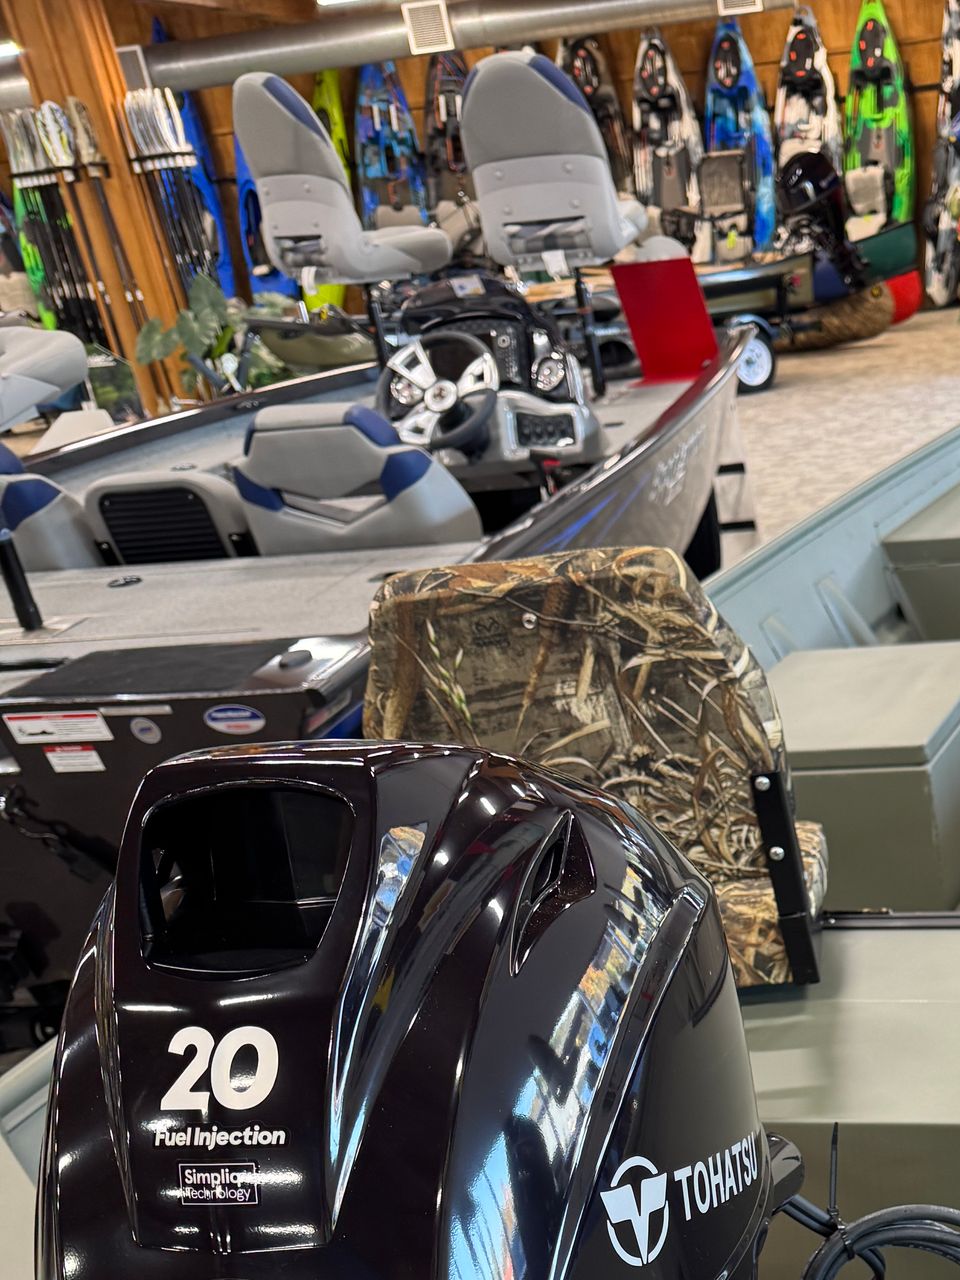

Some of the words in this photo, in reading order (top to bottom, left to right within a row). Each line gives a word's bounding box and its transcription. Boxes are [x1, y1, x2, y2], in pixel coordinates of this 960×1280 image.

[160, 1026, 279, 1111] 20
[154, 1126, 191, 1147] Fuel
[193, 1125, 286, 1151] Injection
[185, 1186, 251, 1202] Technology
[673, 1131, 759, 1222] TOHATSU
